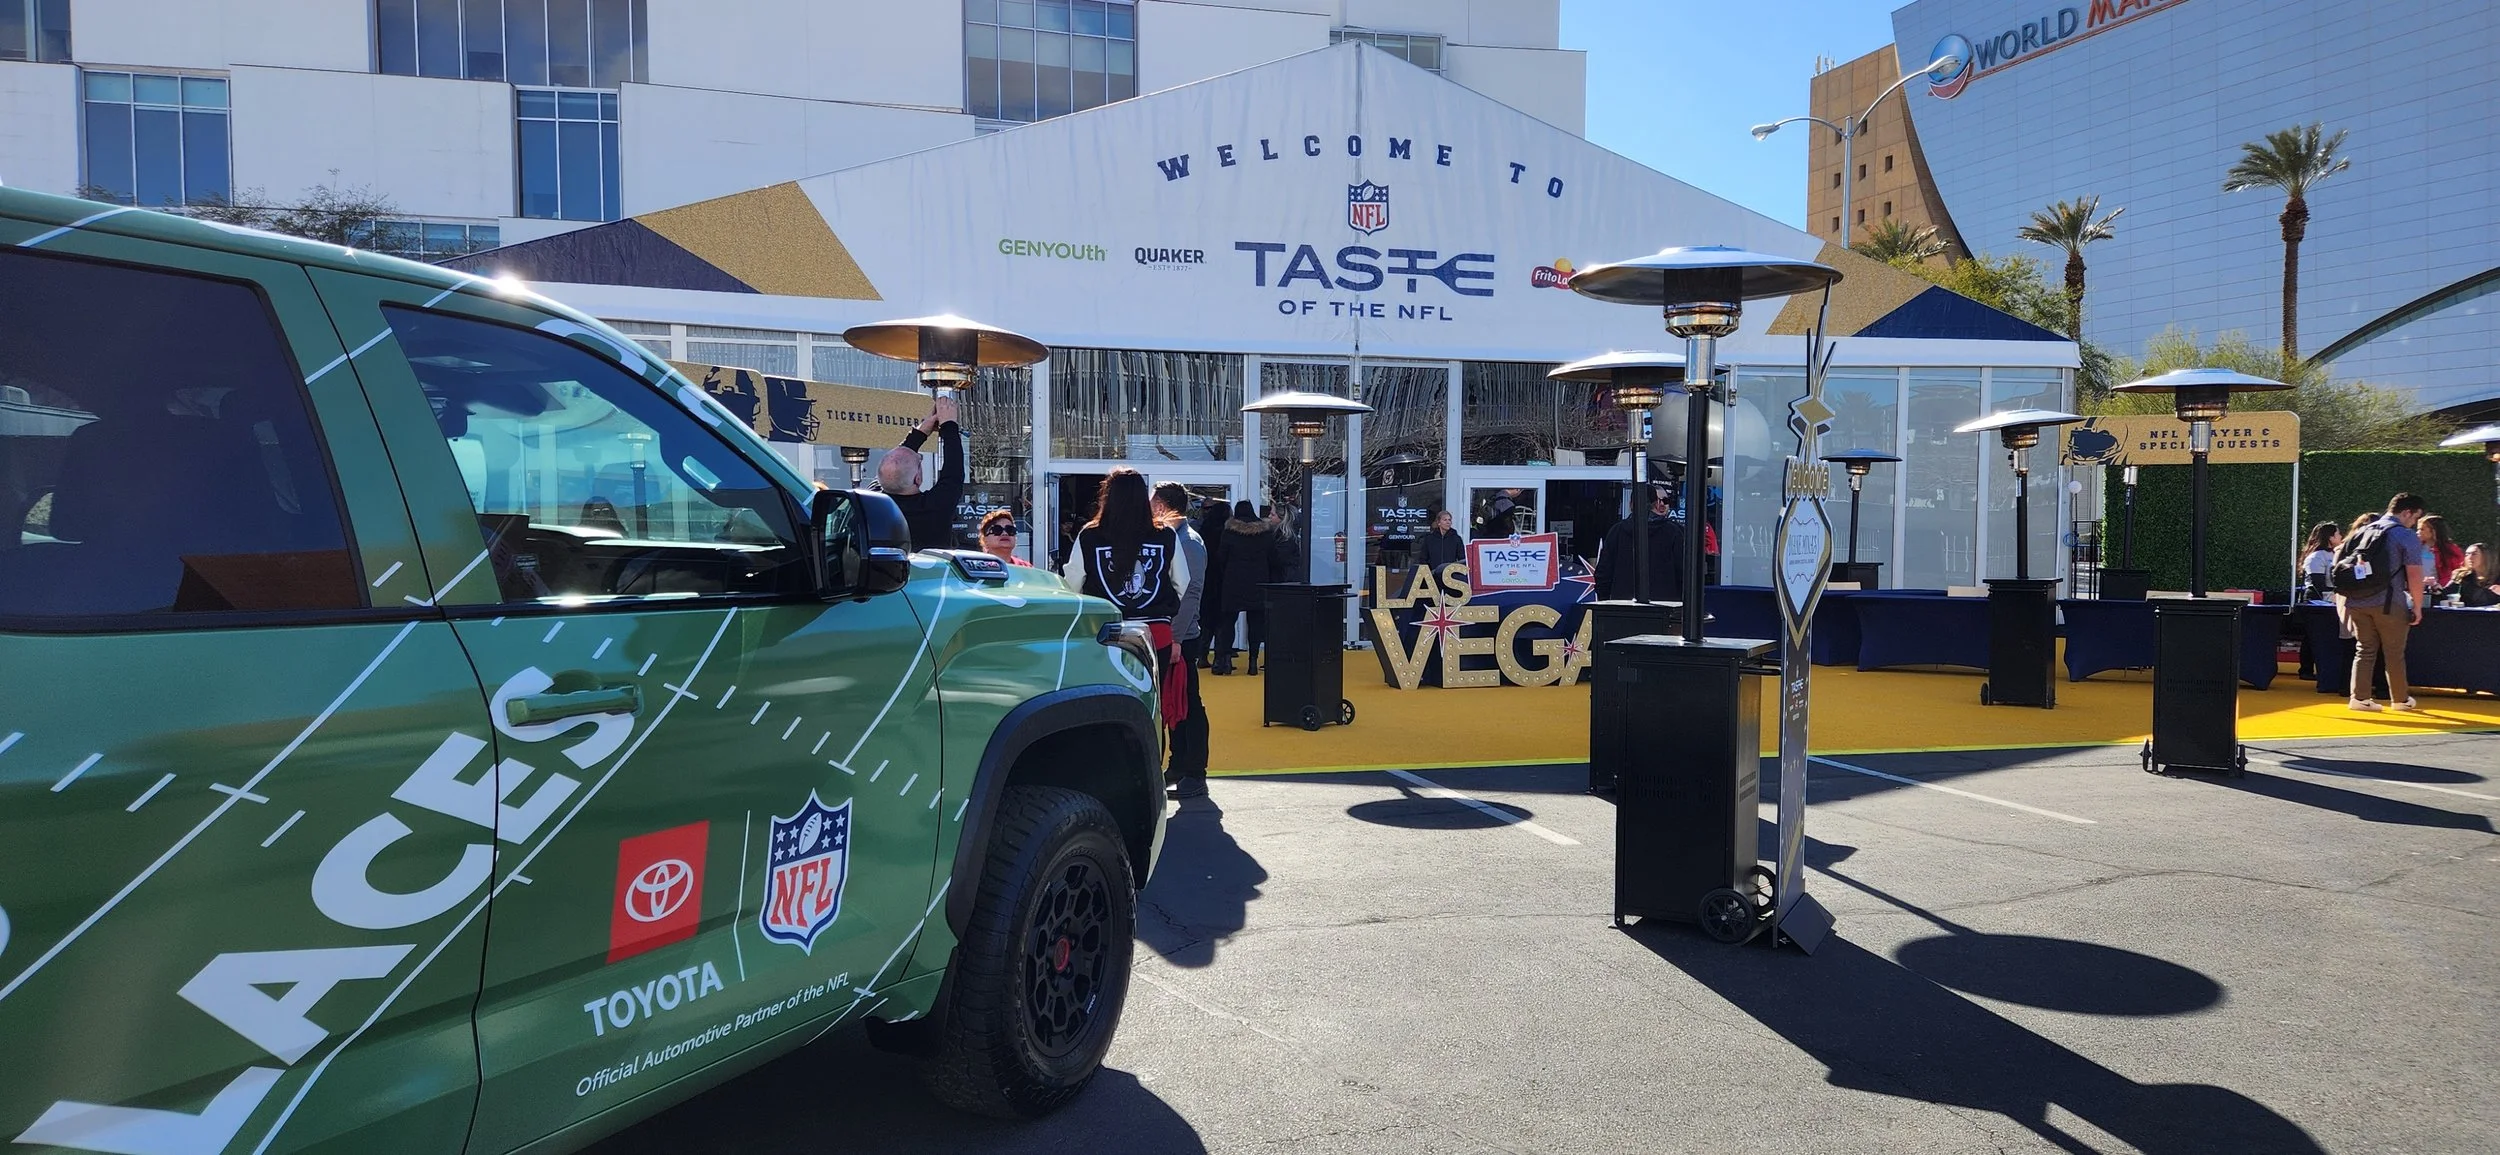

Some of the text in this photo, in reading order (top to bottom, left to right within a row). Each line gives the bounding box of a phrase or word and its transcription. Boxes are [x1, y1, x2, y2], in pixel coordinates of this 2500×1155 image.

[1975, 7, 2079, 70] WORLD
[1157, 135, 1564, 198] WELCOME TO
[1351, 203, 1386, 229] NFL
[1134, 247, 1205, 265] QUAKER
[1234, 241, 1495, 297] TASTE
[1278, 299, 1453, 321] OF THE NFL
[827, 409, 871, 423] TICKET
[2150, 430, 2179, 439] NFL
[2188, 428, 2252, 438] AYER
[2139, 439, 2281, 450] SPECI GUESTS
[1378, 508, 1427, 518] TASTE
[1484, 550, 1546, 562] TASTE
[1376, 563, 1473, 609] LAS
[1370, 604, 1593, 690] VEGA
[769, 856, 835, 929] NFL
[583, 960, 725, 1037] TOYOTA
[575, 972, 850, 1097] Official Automotive Partner of the NFL
